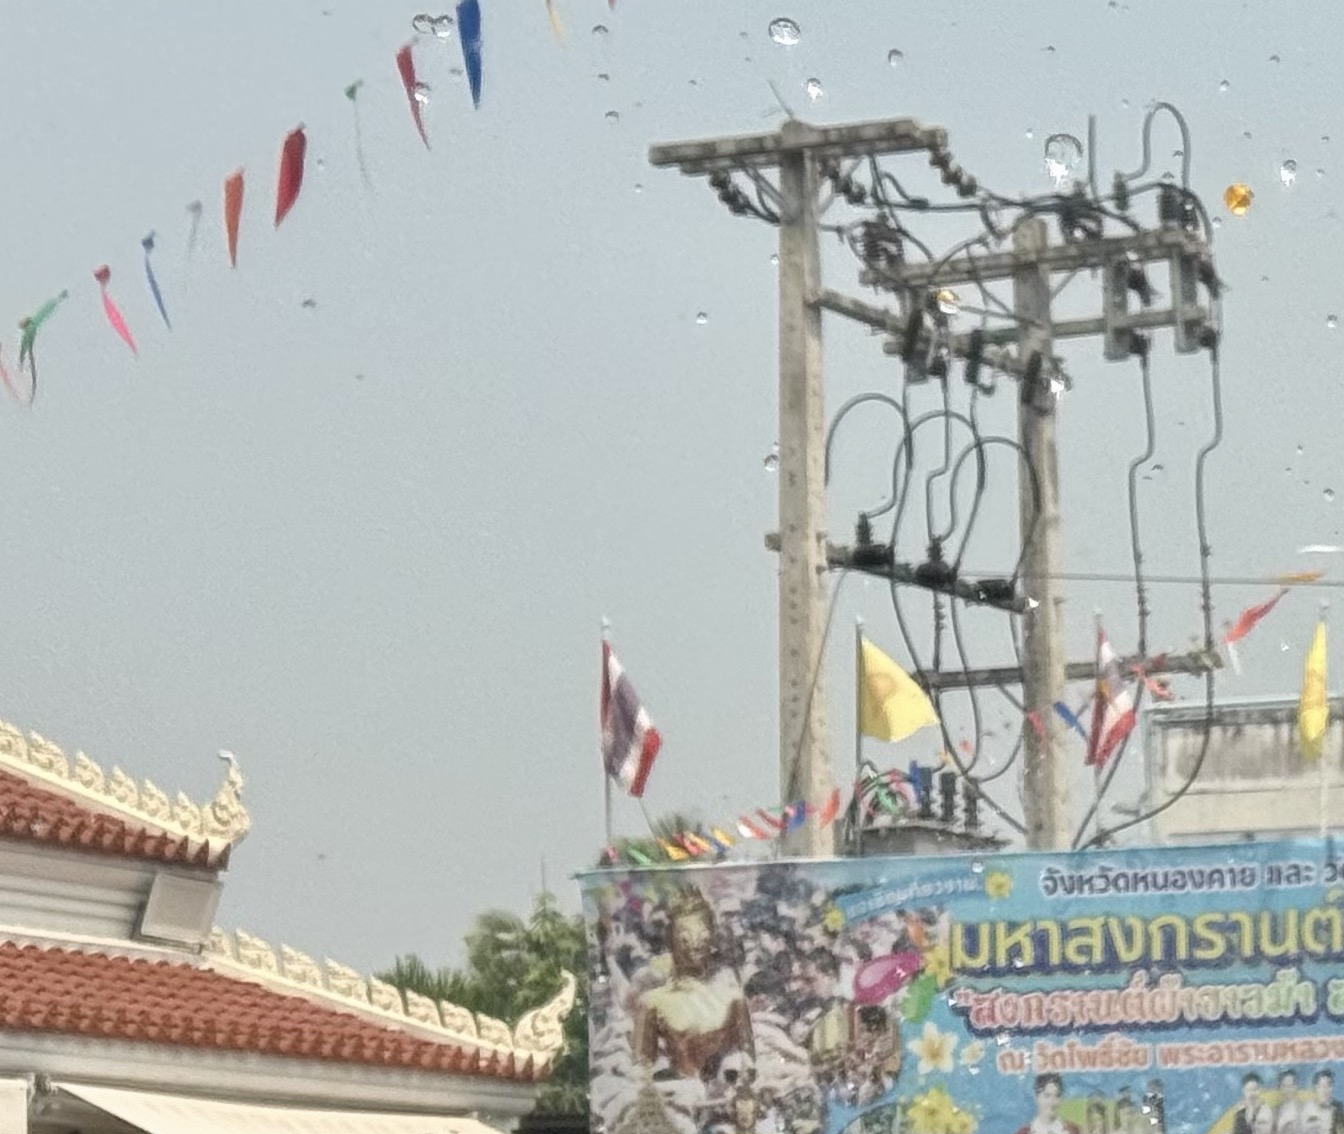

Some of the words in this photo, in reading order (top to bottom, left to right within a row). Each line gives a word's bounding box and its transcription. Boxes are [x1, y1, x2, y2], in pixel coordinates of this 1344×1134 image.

[1043, 865, 1256, 895] จังหวัดหนองคาย
[1267, 863, 1313, 885] และ
